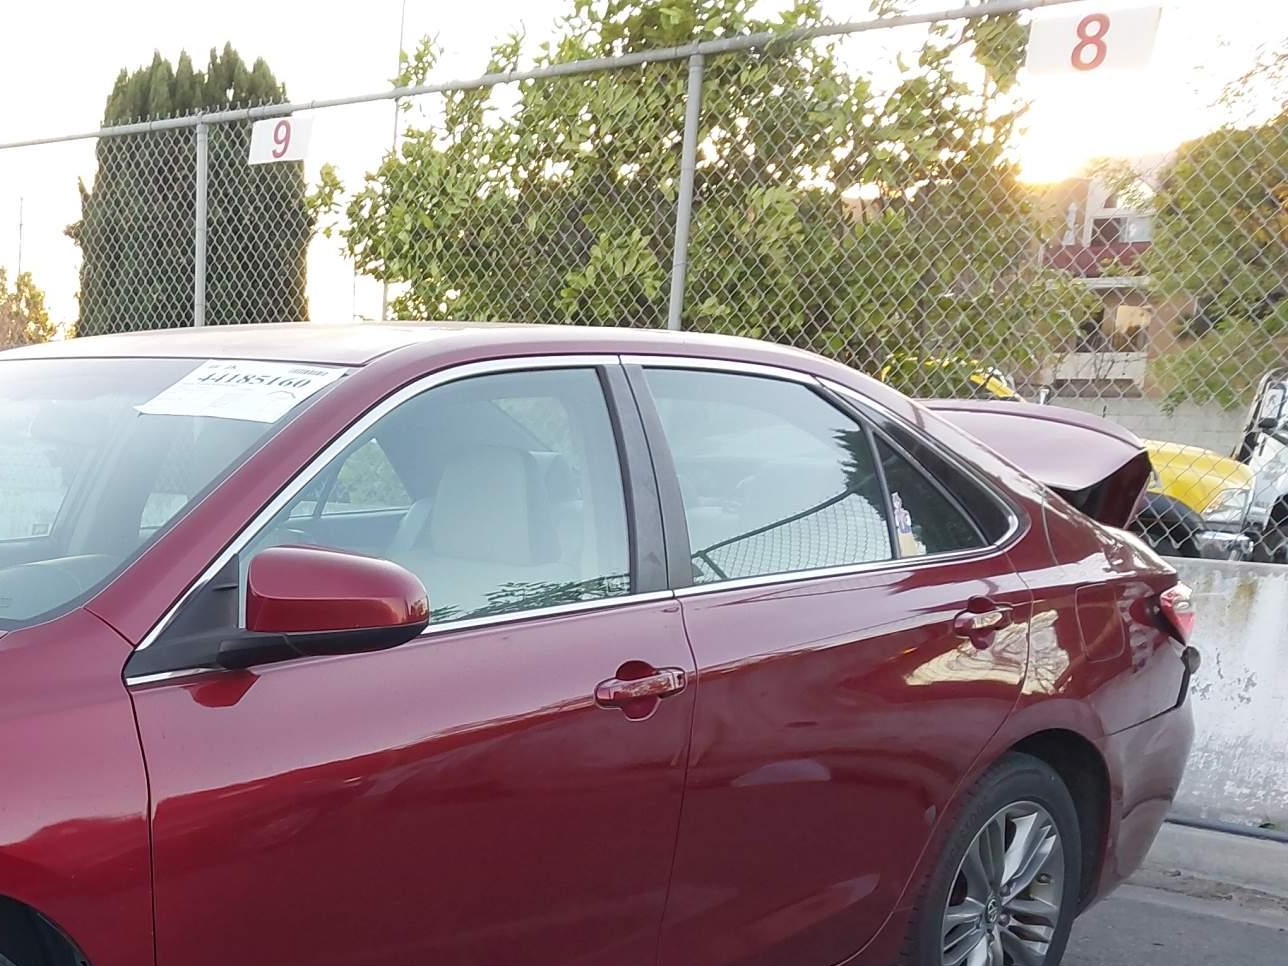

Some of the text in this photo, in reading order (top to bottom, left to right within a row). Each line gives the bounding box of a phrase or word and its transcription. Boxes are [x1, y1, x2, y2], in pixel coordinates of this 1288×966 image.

[1070, 13, 1111, 71] 8
[272, 119, 292, 159] 9
[197, 371, 312, 389] 44185160
